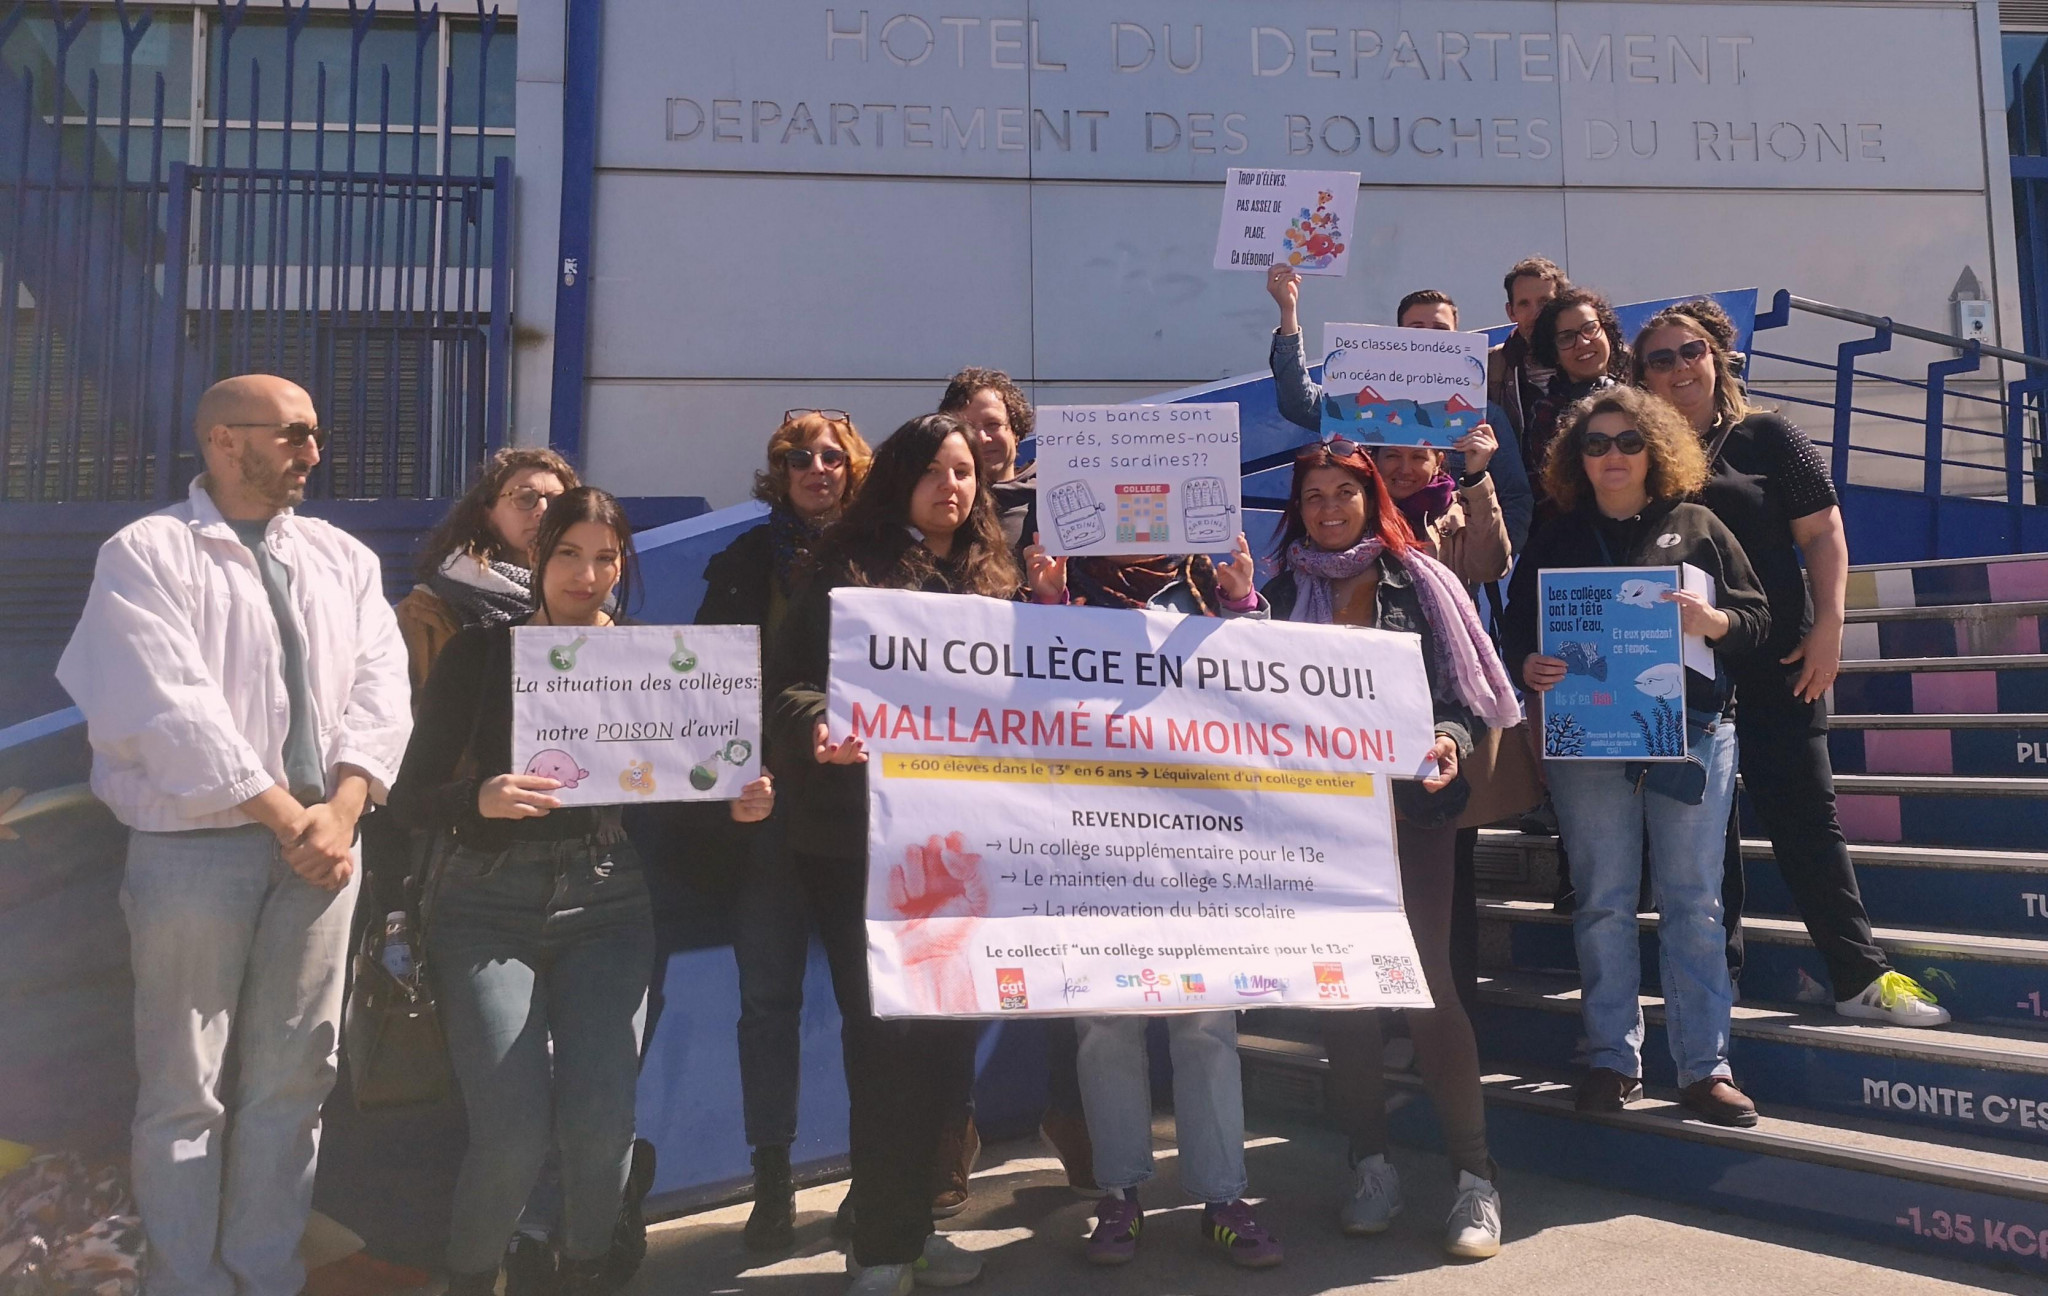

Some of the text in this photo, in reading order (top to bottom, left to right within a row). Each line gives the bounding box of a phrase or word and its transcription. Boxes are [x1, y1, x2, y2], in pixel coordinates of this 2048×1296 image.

[825, 8, 1754, 85] HOTEL DU DEPARTEMENT
[665, 97, 1887, 164] DEPARTEMENT DES BOUCHES DU RHONE
[1236, 199, 1282, 213] PAS ASSEZ DE
[1335, 337, 1359, 349] Des
[1361, 339, 1408, 351] classes
[1411, 341, 1462, 354] bondées
[1332, 370, 1470, 386] un océan de problèmes
[1062, 409, 1213, 423] Nos bancs sont
[1036, 431, 1239, 447] serrés, sommes-nous
[1068, 453, 1209, 468] des sardines??
[1123, 485, 1163, 494] COLLEGE
[1549, 584, 1612, 600] Les collèges
[1549, 601, 1603, 616] ont la tête
[1550, 620, 1574, 632] sous
[1612, 627, 1673, 641] Et eux pendant
[1613, 645, 1623, 654] ce
[868, 634, 1376, 701] UN COLLÈGE EN PLUS OUI!
[515, 673, 758, 695] La situation des collèges:
[536, 718, 739, 741] notre POISON d'avril
[852, 701, 1396, 763] MALLARMÉ EN MOINS NON!
[2017, 742, 2048, 763] PL
[910, 760, 940, 772] 600
[943, 760, 989, 773] élèves
[993, 761, 1028, 775] dans
[1031, 762, 1043, 775] le
[1074, 767, 1092, 777] en
[1095, 765, 1104, 777] 6
[1108, 767, 1132, 778] ans
[1153, 768, 1231, 784] L'équivalent
[1234, 769, 1262, 784] d'un
[1265, 772, 1313, 788] collège
[1315, 774, 1356, 789] entier
[1071, 810, 1244, 832] REVENDICATIONS
[1009, 837, 1325, 864] Un collège supplémentaire pour le 13e
[1024, 869, 1314, 892] Le maintien du collège S.Mallarmé
[1046, 900, 1296, 919] La rénovation du bâti scolaire
[985, 945, 1003, 958] Le
[1006, 943, 1068, 957] collectif
[1104, 943, 1154, 959] collège
[1158, 943, 1270, 959] supplémentaire
[1275, 945, 1307, 957] pour
[1310, 943, 1324, 954] le
[999, 980, 1025, 994] cgt
[1115, 968, 1171, 988] snes
[1318, 979, 1349, 998] cgt
[1863, 1077, 1975, 1120] MONTE
[1895, 1206, 1976, 1245] -1.35
